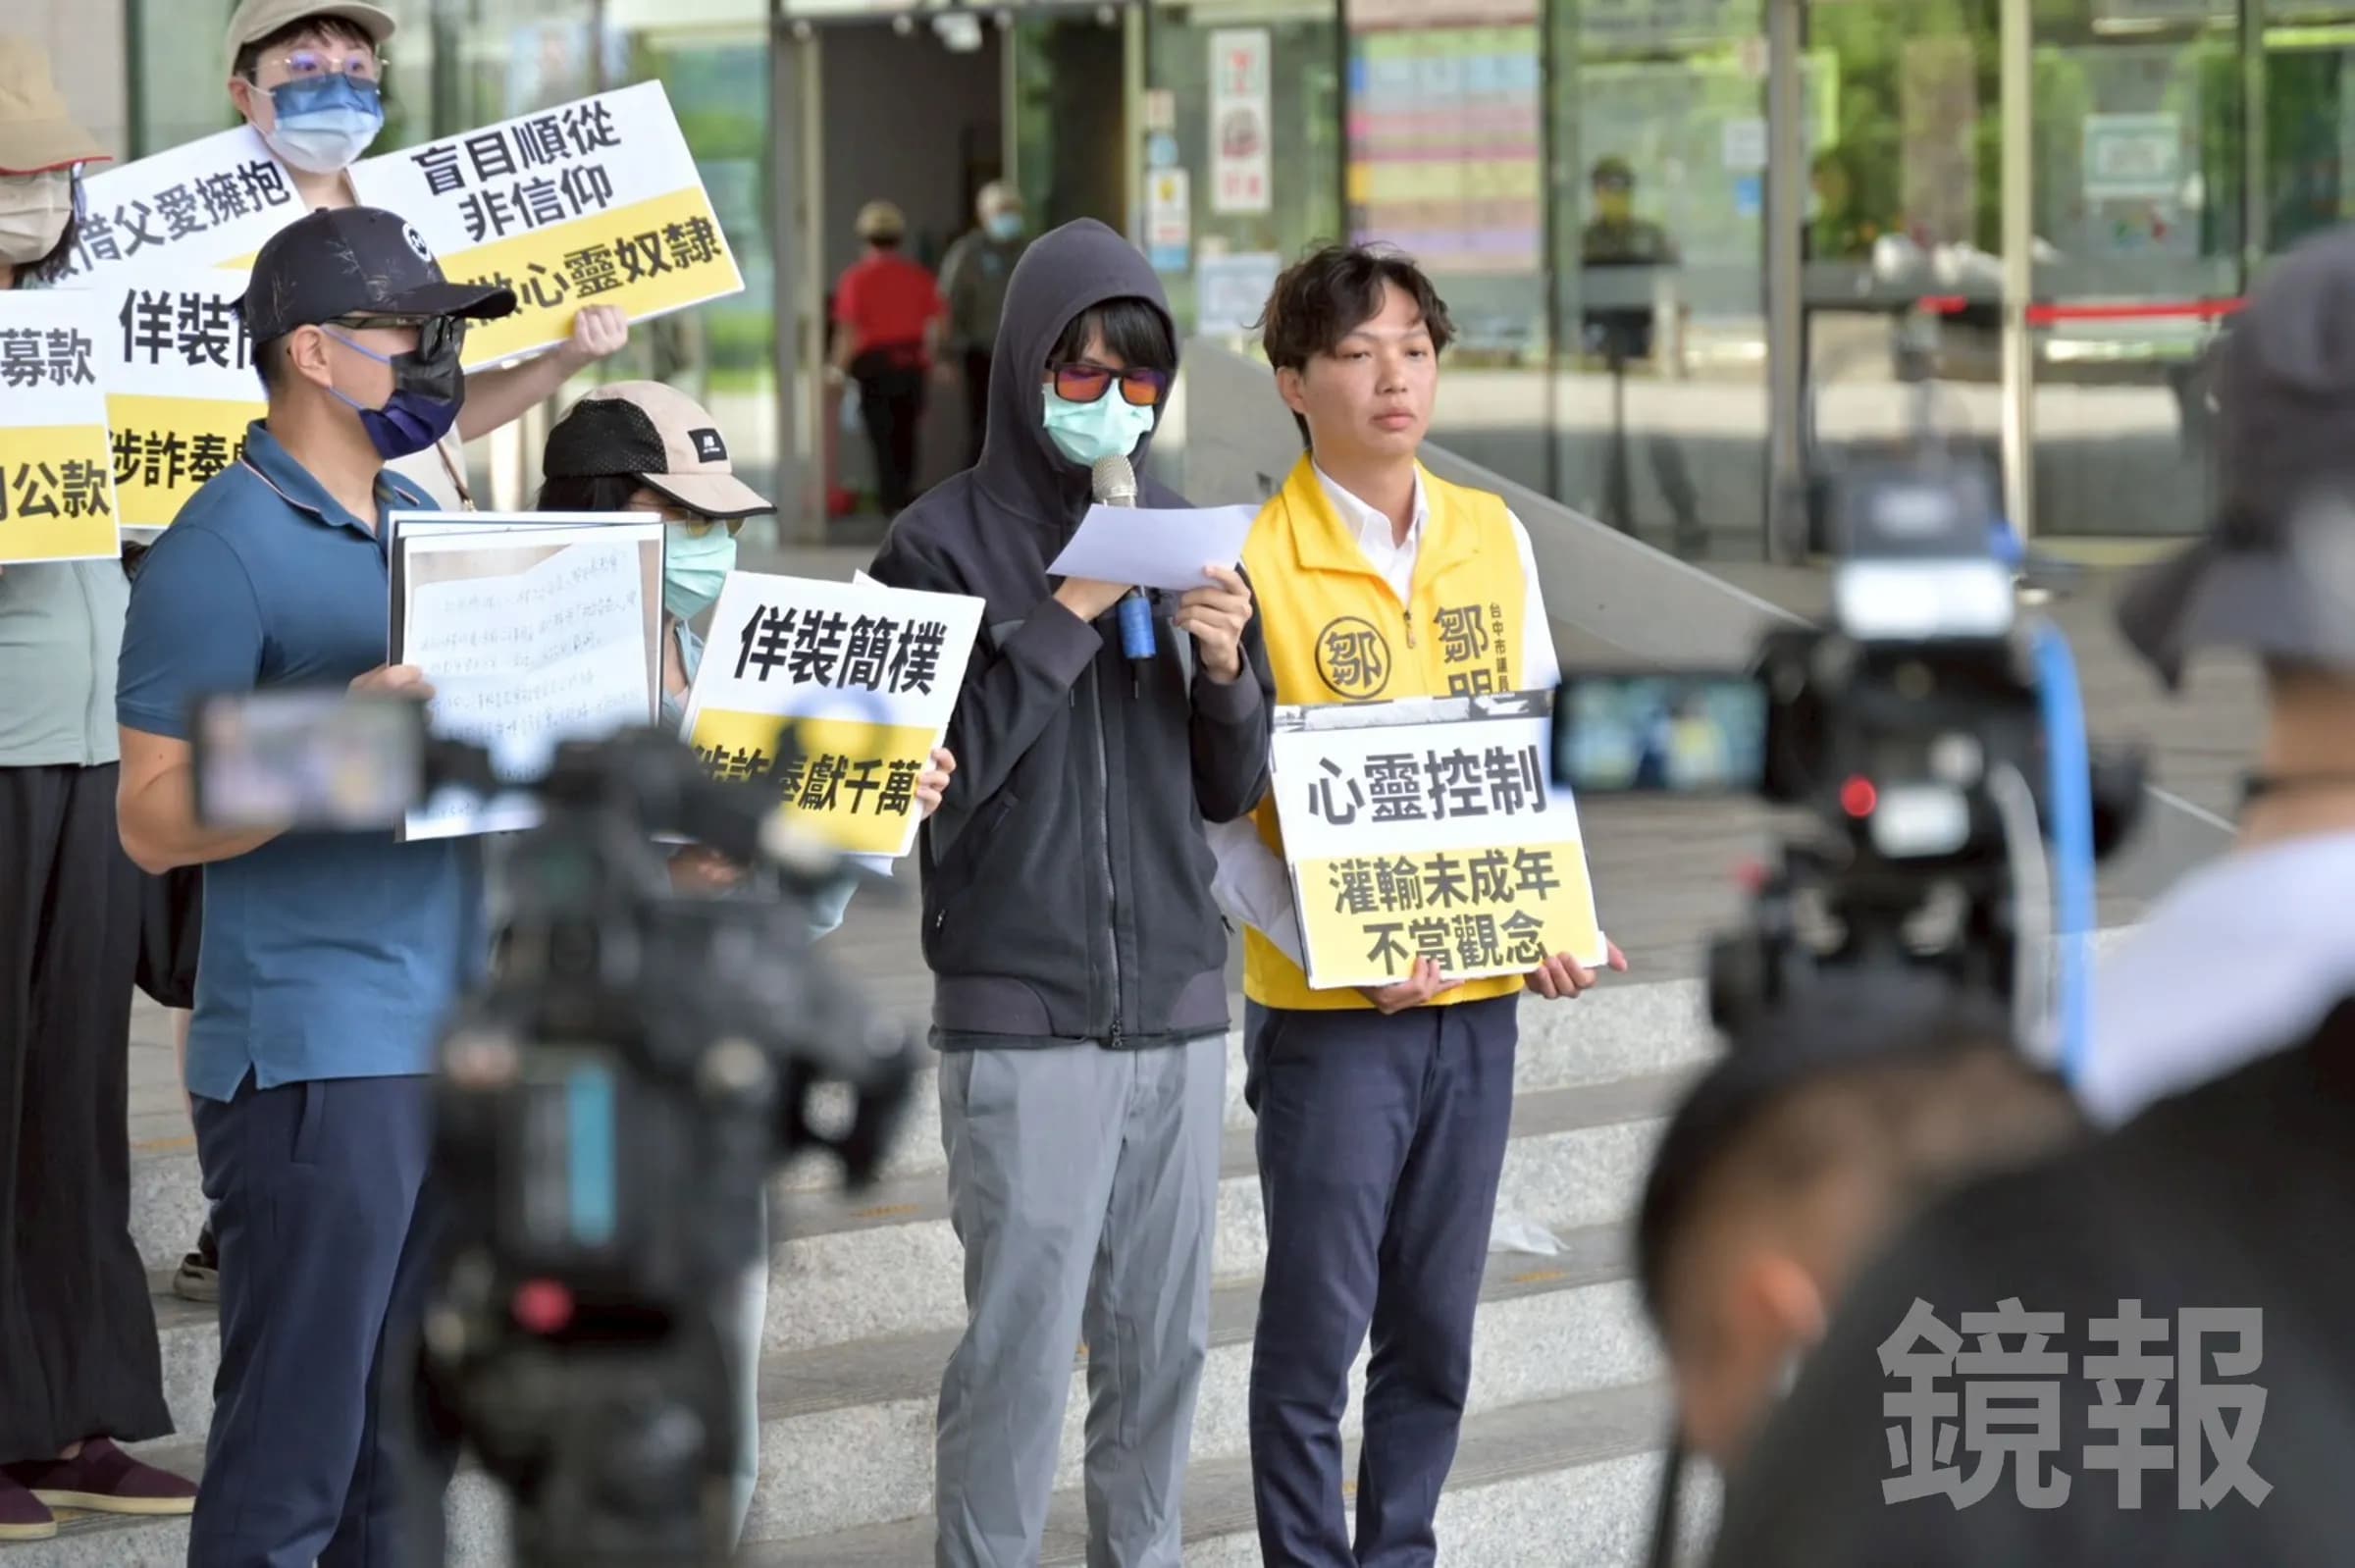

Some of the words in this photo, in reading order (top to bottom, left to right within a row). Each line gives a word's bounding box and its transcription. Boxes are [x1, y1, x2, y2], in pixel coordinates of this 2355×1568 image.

[410, 100, 622, 196] 盲目順從
[59, 160, 291, 281] 借父愛擁抱
[458, 164, 614, 242] 非信仰
[0, 459, 110, 521] 公款
[109, 429, 247, 489] 涉詐奉
[735, 604, 949, 695] 佯裝簡樸
[1325, 631, 1382, 688] 鄒
[1308, 745, 1547, 825] 心靈控制
[1329, 847, 1560, 915] 灌輸未成年
[1363, 910, 1548, 975] 不當觀念
